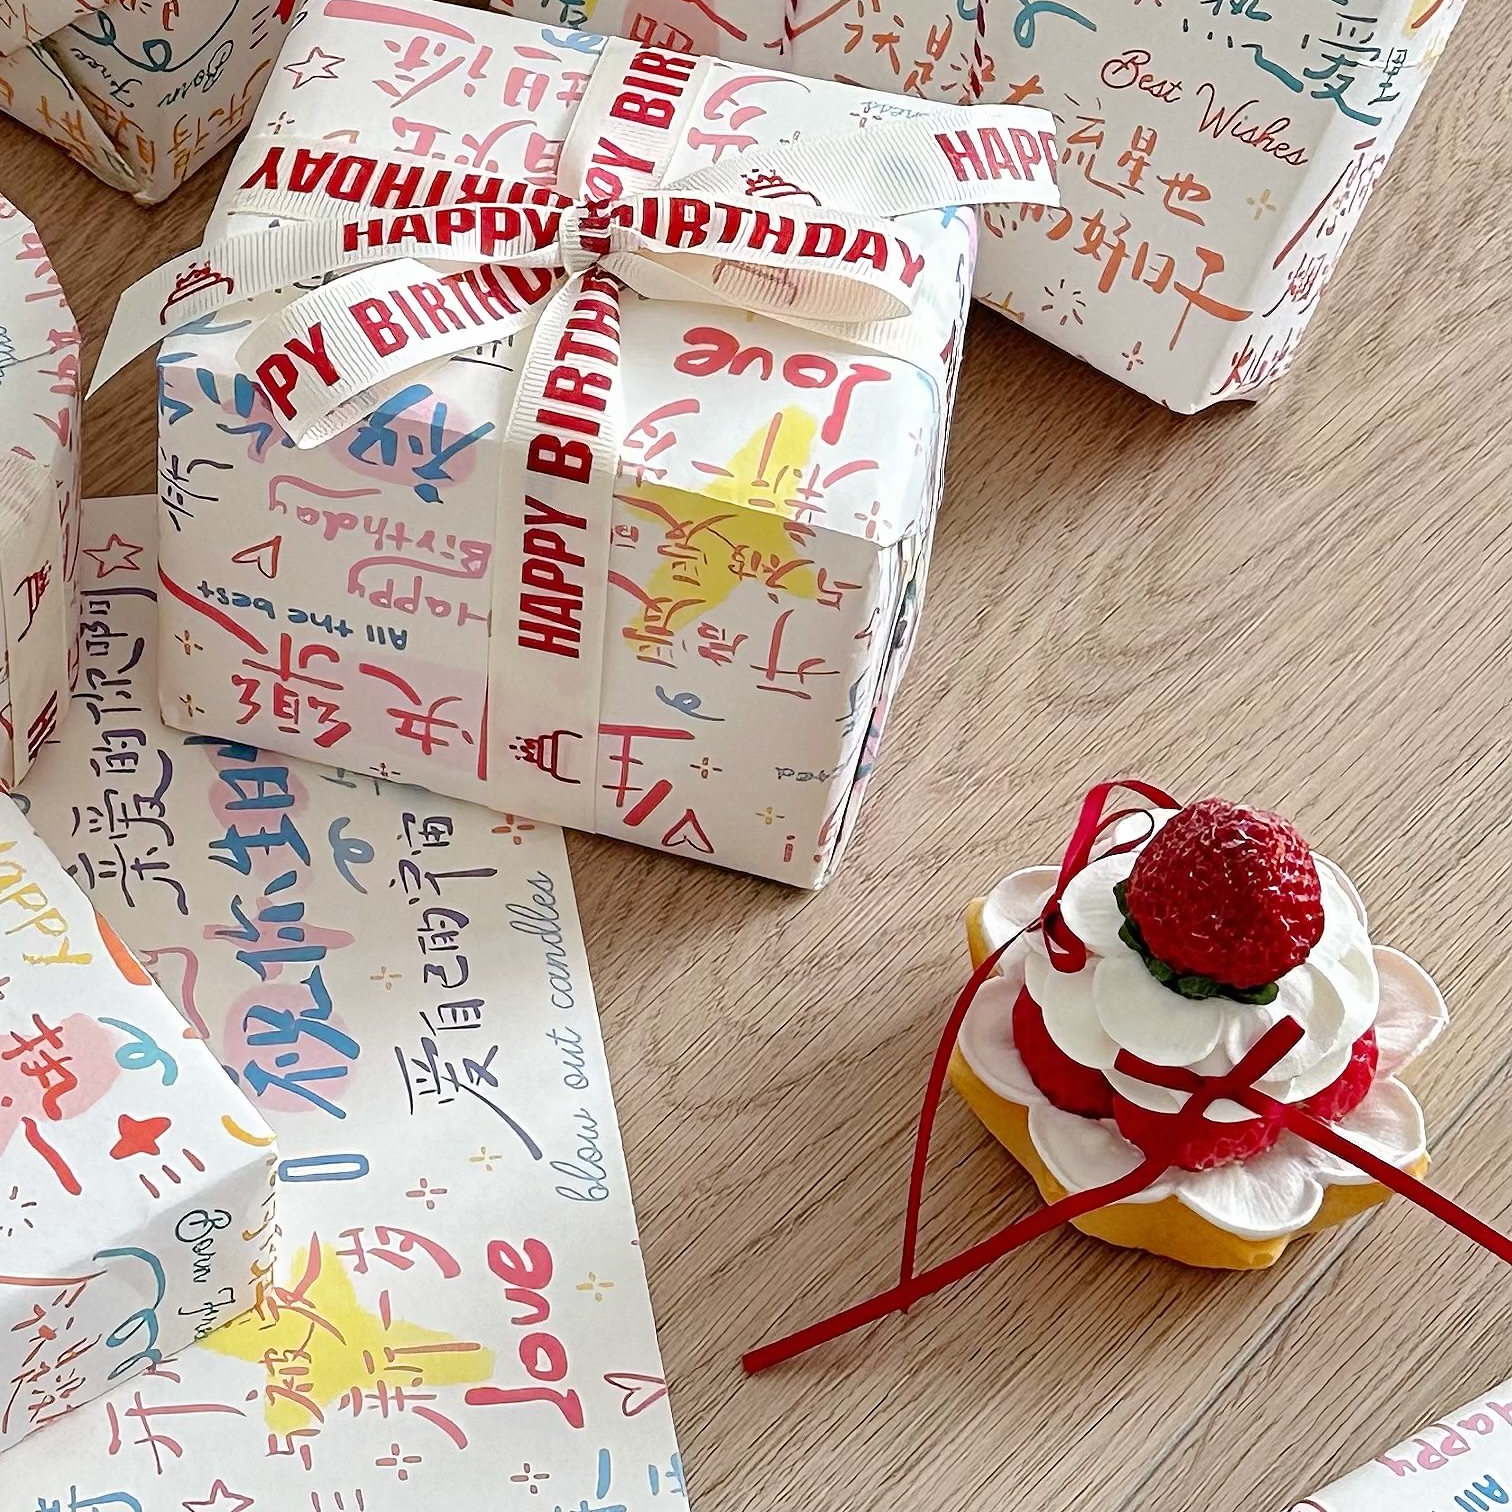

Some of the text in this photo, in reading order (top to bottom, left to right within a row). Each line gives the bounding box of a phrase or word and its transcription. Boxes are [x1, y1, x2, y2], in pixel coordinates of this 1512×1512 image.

[934, 126, 1060, 185] HAPP
[1099, 48, 1312, 167] Best Wishes
[343, 206, 562, 256] HAPPY
[348, 262, 567, 359] BIRTHD
[196, 577, 409, 652] All the best
[516, 492, 590, 659] HAPPY
[503, 870, 610, 1205] blow out candles
